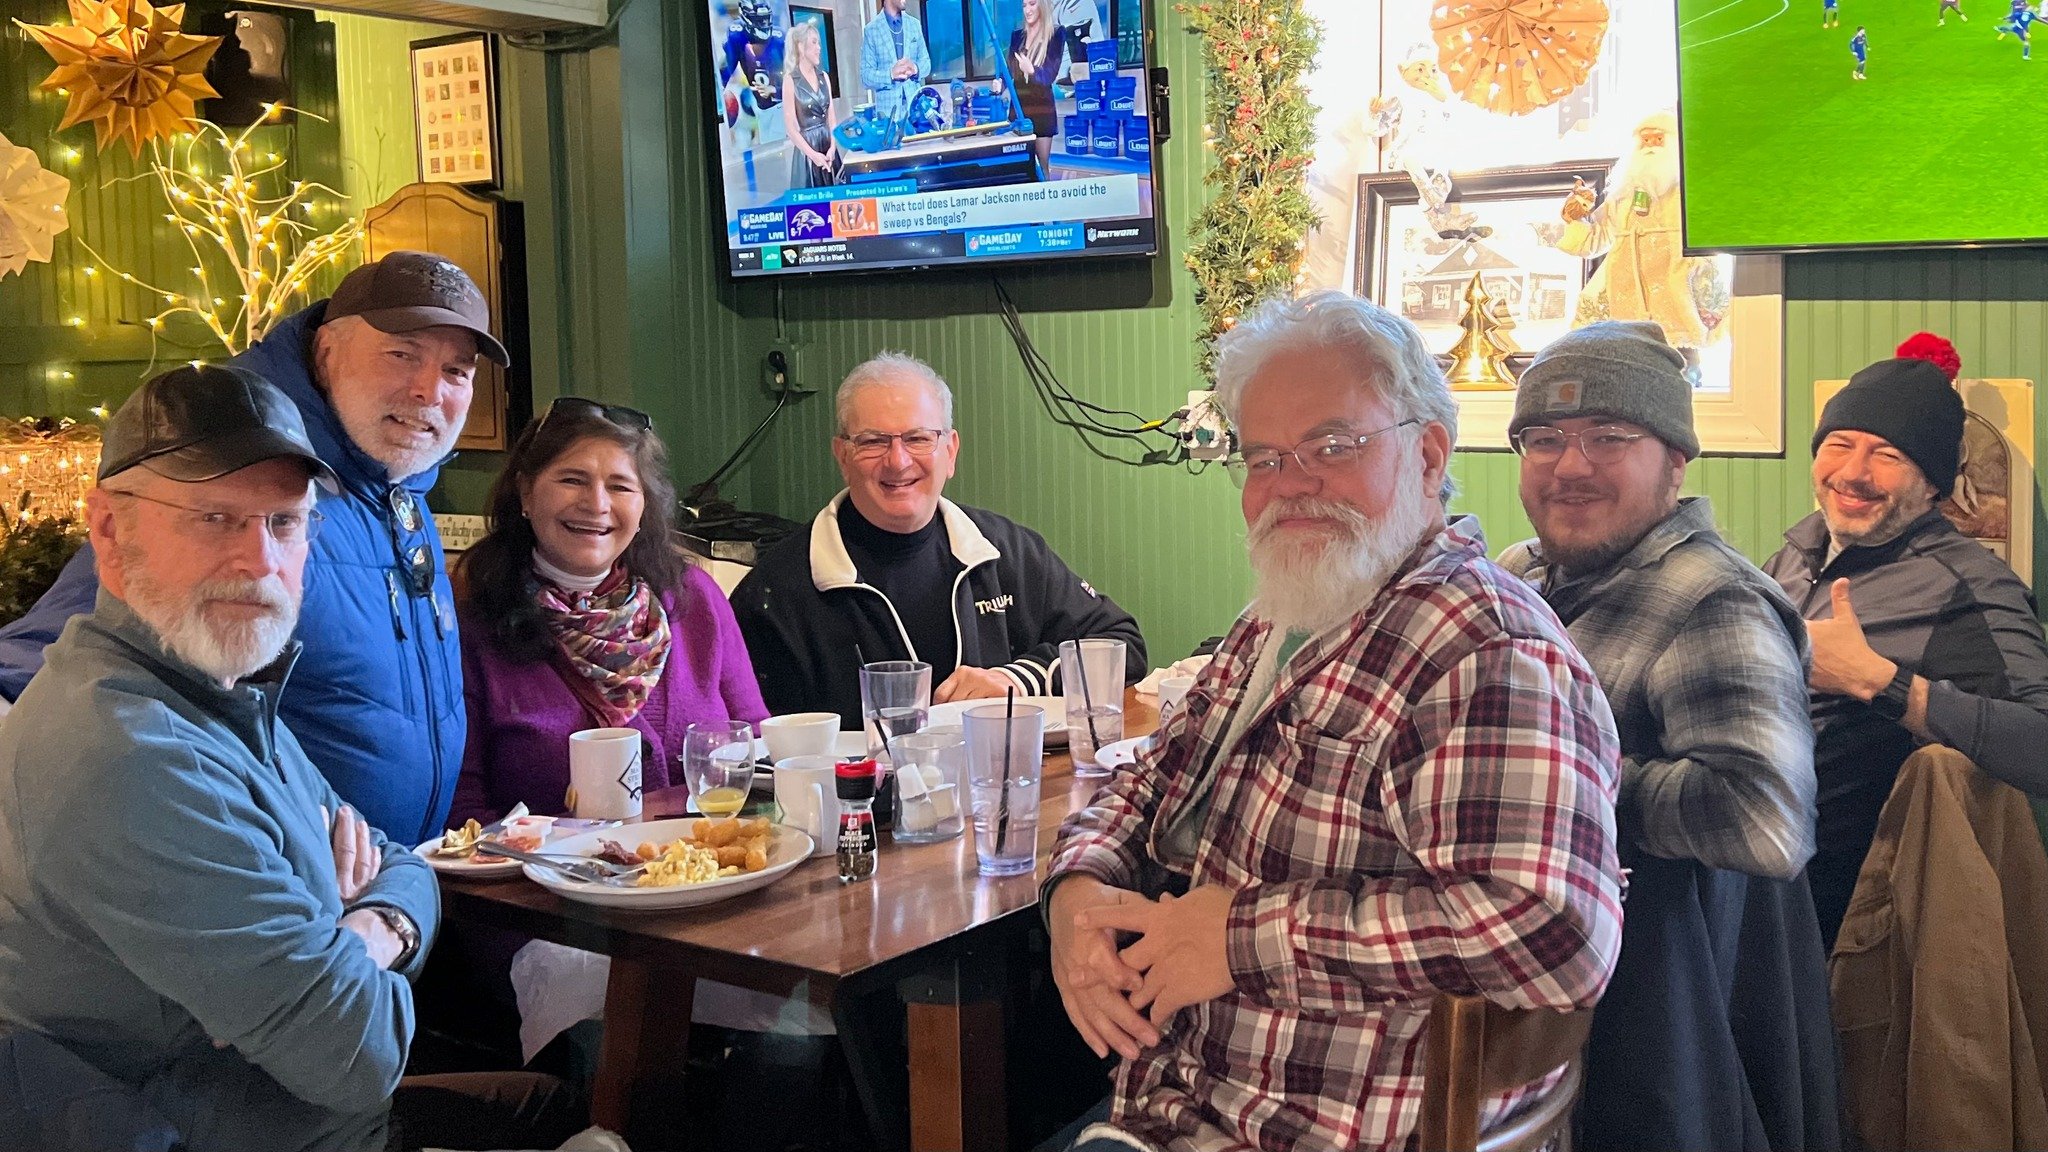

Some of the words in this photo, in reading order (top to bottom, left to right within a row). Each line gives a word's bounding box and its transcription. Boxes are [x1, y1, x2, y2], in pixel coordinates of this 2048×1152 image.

[1092, 62, 1112, 71] LOWE'S
[1002, 143, 1027, 153] KOBALT
[846, 187, 877, 196] Presented
[878, 187, 885, 195] by
[883, 201, 905, 212] What
[927, 198, 948, 210] does
[950, 196, 978, 208] Lamar
[981, 192, 1020, 205] Jackson
[1023, 188, 1046, 201] need
[1048, 188, 1058, 199] to
[1061, 185, 1087, 198] avoid
[1090, 183, 1107, 195] the
[884, 218, 911, 229] sweep
[914, 216, 924, 226] vs
[926, 211, 967, 227] Bengals?
[768, 231, 785, 240] LIVE
[1037, 228, 1074, 239] TONIGHT
[1097, 229, 1139, 239] NETWORK
[828, 244, 847, 252] NOTES
